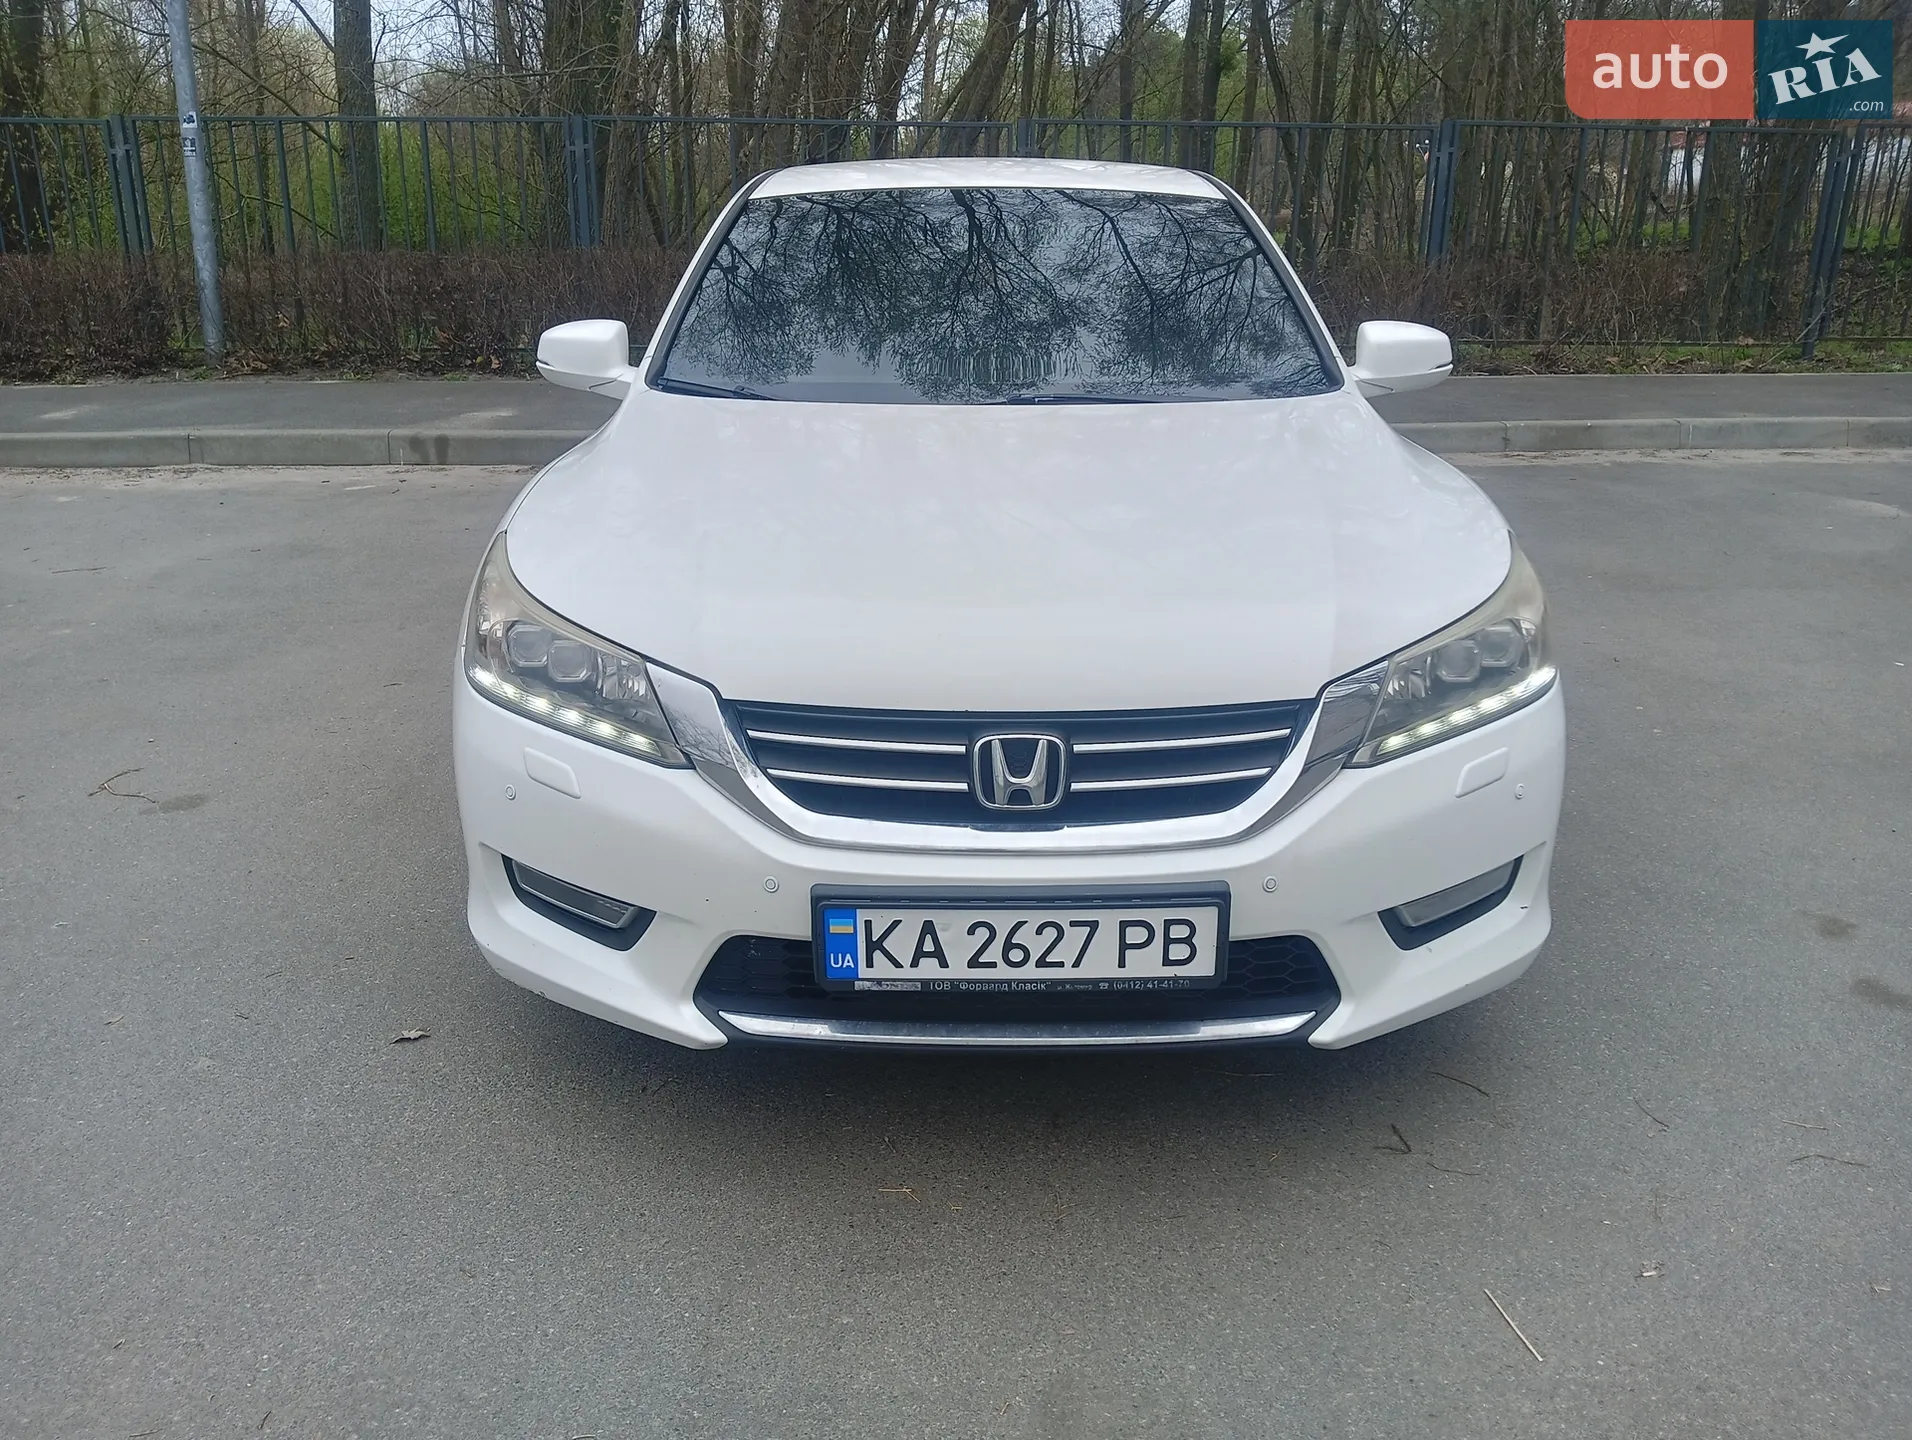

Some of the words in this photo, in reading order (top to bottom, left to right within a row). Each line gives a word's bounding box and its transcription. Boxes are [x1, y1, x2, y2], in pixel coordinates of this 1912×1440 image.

[864, 919, 950, 969] KA
[966, 919, 1100, 969] 2627
[1117, 918, 1197, 969] PB
[830, 953, 855, 968] UA
